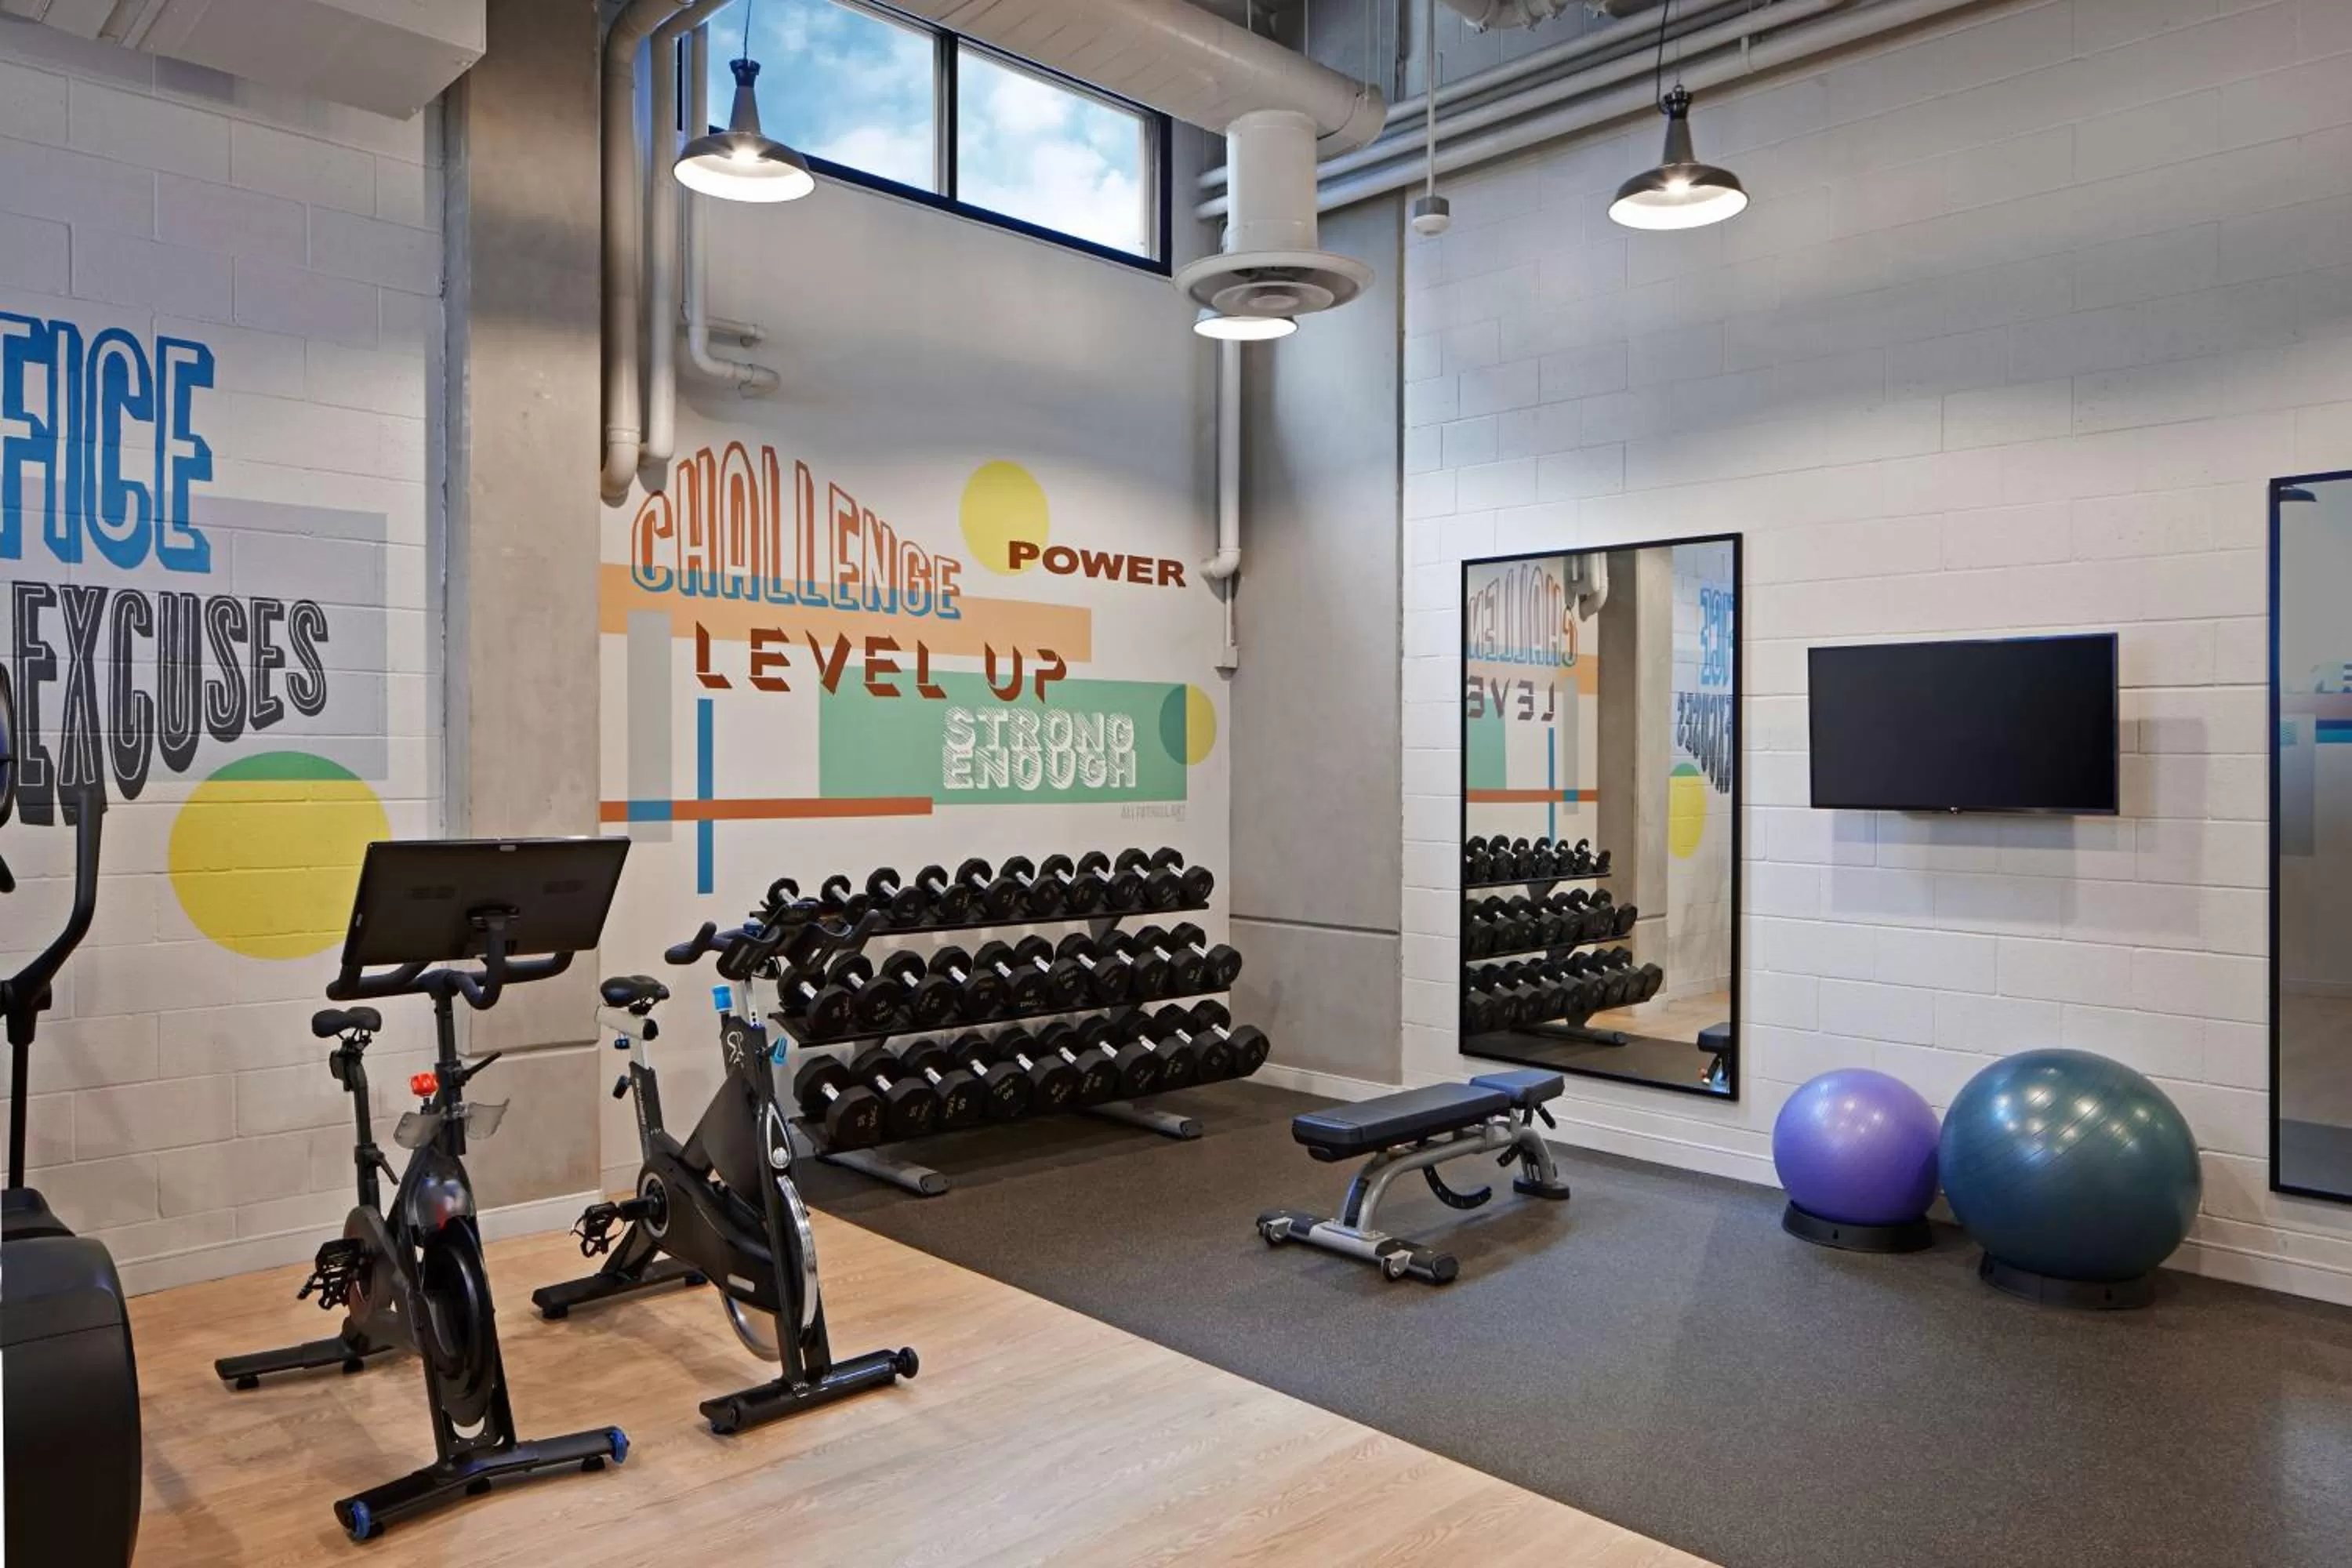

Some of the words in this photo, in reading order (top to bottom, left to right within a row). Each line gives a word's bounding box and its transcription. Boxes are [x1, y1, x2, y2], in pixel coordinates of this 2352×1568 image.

[631, 441, 962, 620] CHALLENGE
[1007, 539, 1186, 588] POWER
[695, 621, 948, 699] LEVEL
[985, 641, 1068, 704] UP
[12, 581, 328, 826] EXCUSES
[943, 706, 1135, 752] STRONG
[942, 745, 1136, 790] ENOUGH
